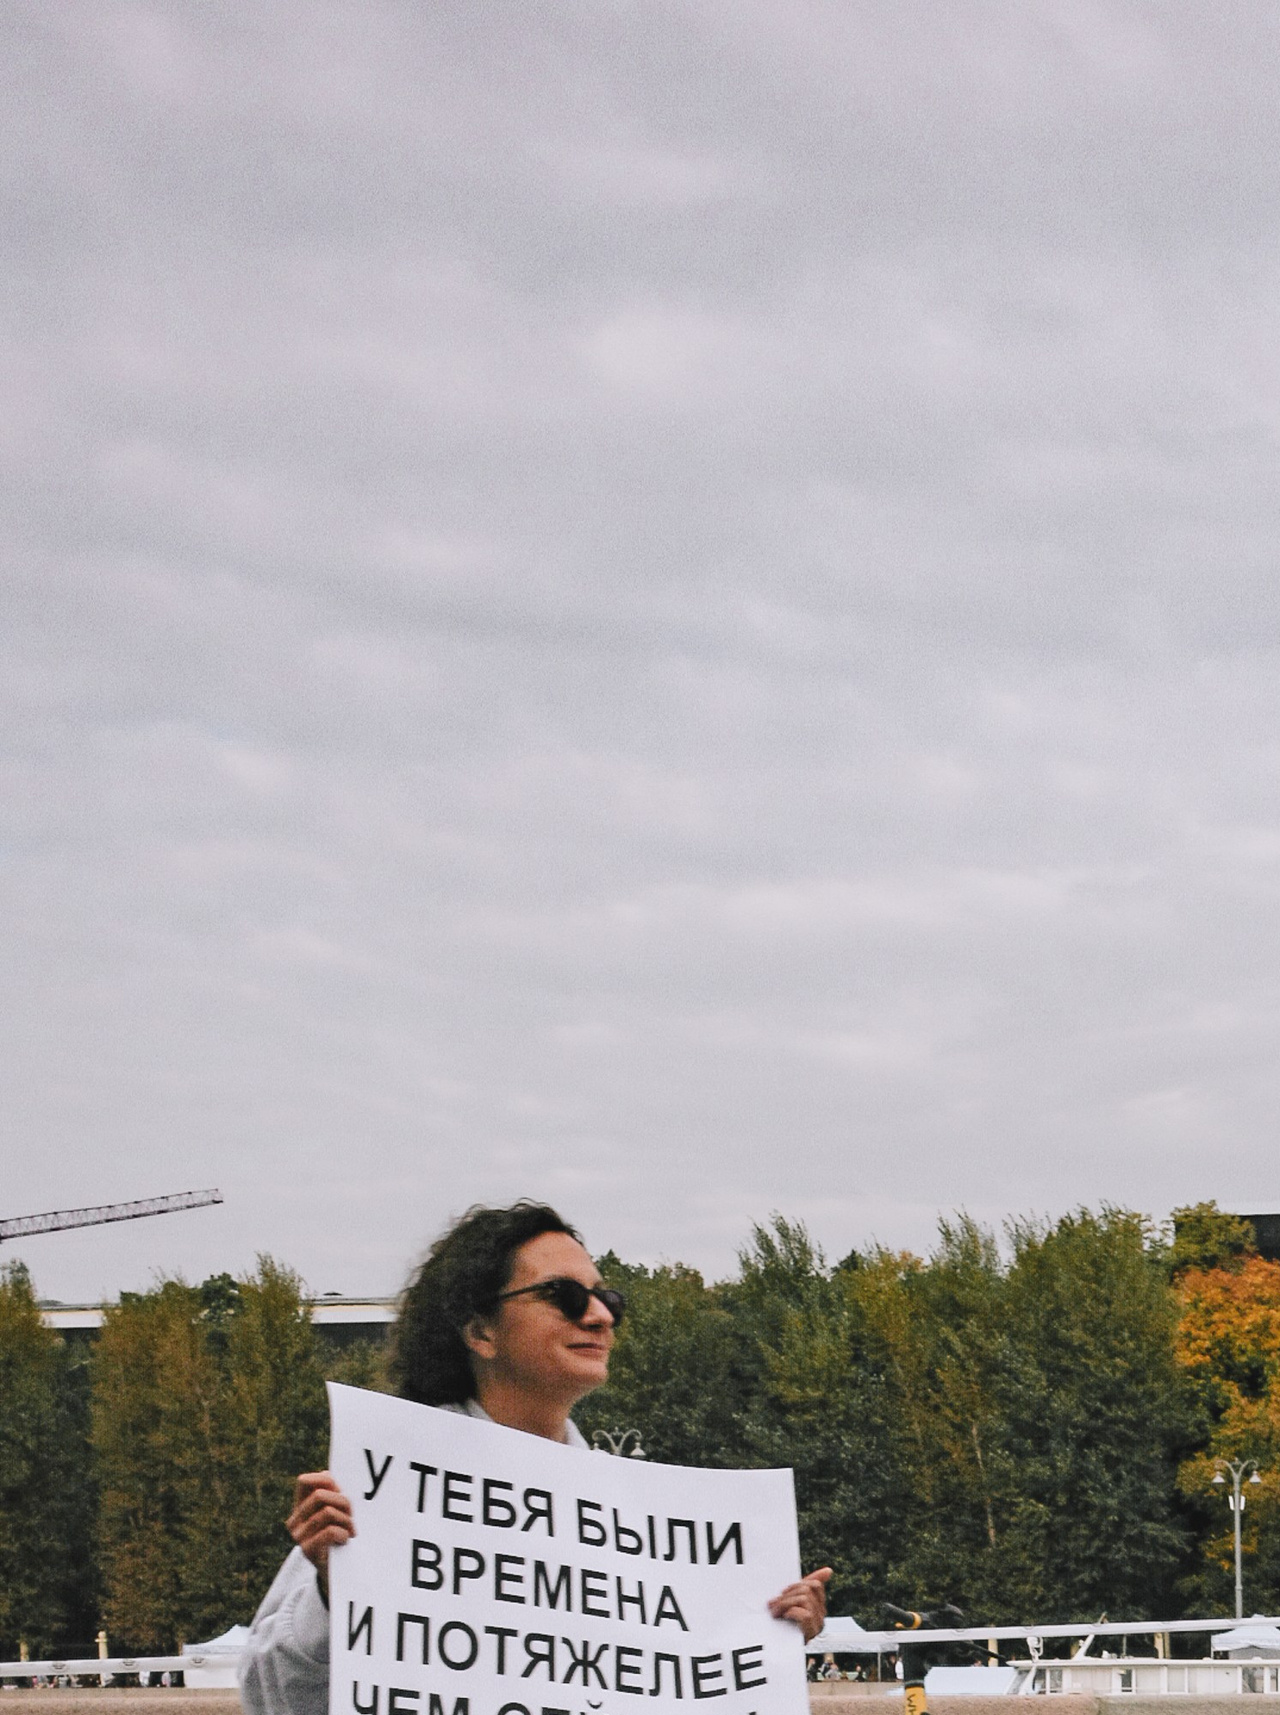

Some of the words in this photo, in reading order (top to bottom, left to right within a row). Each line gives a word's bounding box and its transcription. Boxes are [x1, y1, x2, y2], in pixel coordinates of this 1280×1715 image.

[363, 1448, 392, 1501] У
[410, 1461, 556, 1537] ТЕБЯ
[577, 1498, 745, 1565] БЫЛИ
[411, 1538, 690, 1632] ВРЕМЕНА
[347, 1600, 374, 1656] И
[396, 1612, 767, 1700] ПОТЯЖЕЛЕЕ
